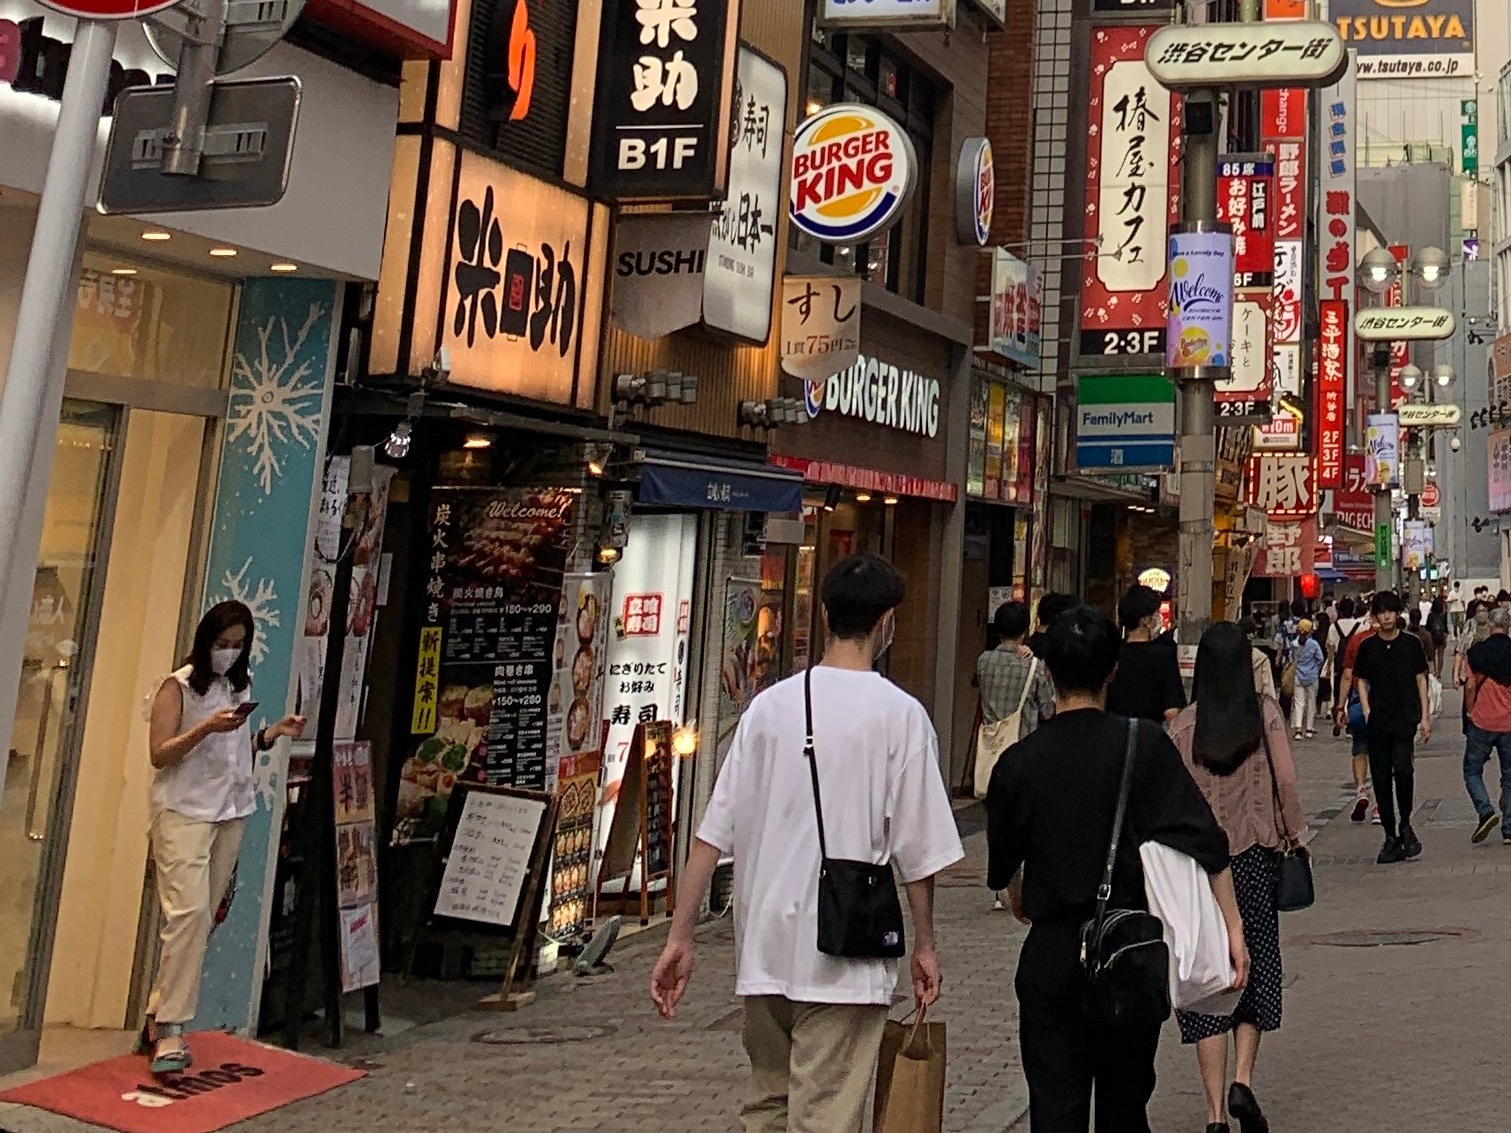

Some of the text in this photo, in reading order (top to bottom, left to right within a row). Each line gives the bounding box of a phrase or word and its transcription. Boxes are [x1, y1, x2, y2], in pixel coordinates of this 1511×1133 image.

[1336, 14, 1467, 41] TSUTAYA
[1157, 37, 1334, 64] 渋谷センター街
[616, 137, 699, 171] B1F
[793, 129, 890, 180] BURGER
[794, 151, 894, 214] KING
[616, 249, 704, 279] SUSHI
[788, 282, 857, 325] すし
[1359, 315, 1449, 330] 渋谷センター街
[825, 354, 941, 438] BURGER KING
[1082, 410, 1154, 429] FamilyMart
[1322, 430, 1340, 444] 2F
[1322, 448, 1340, 462] 3F
[1256, 457, 1310, 510] 豚
[1322, 466, 1340, 480] 4F
[489, 500, 565, 519] Welcome!
[1265, 522, 1302, 575] 野郎
[426, 503, 452, 624] 炭火串焼き
[611, 702, 660, 726] 寿司
